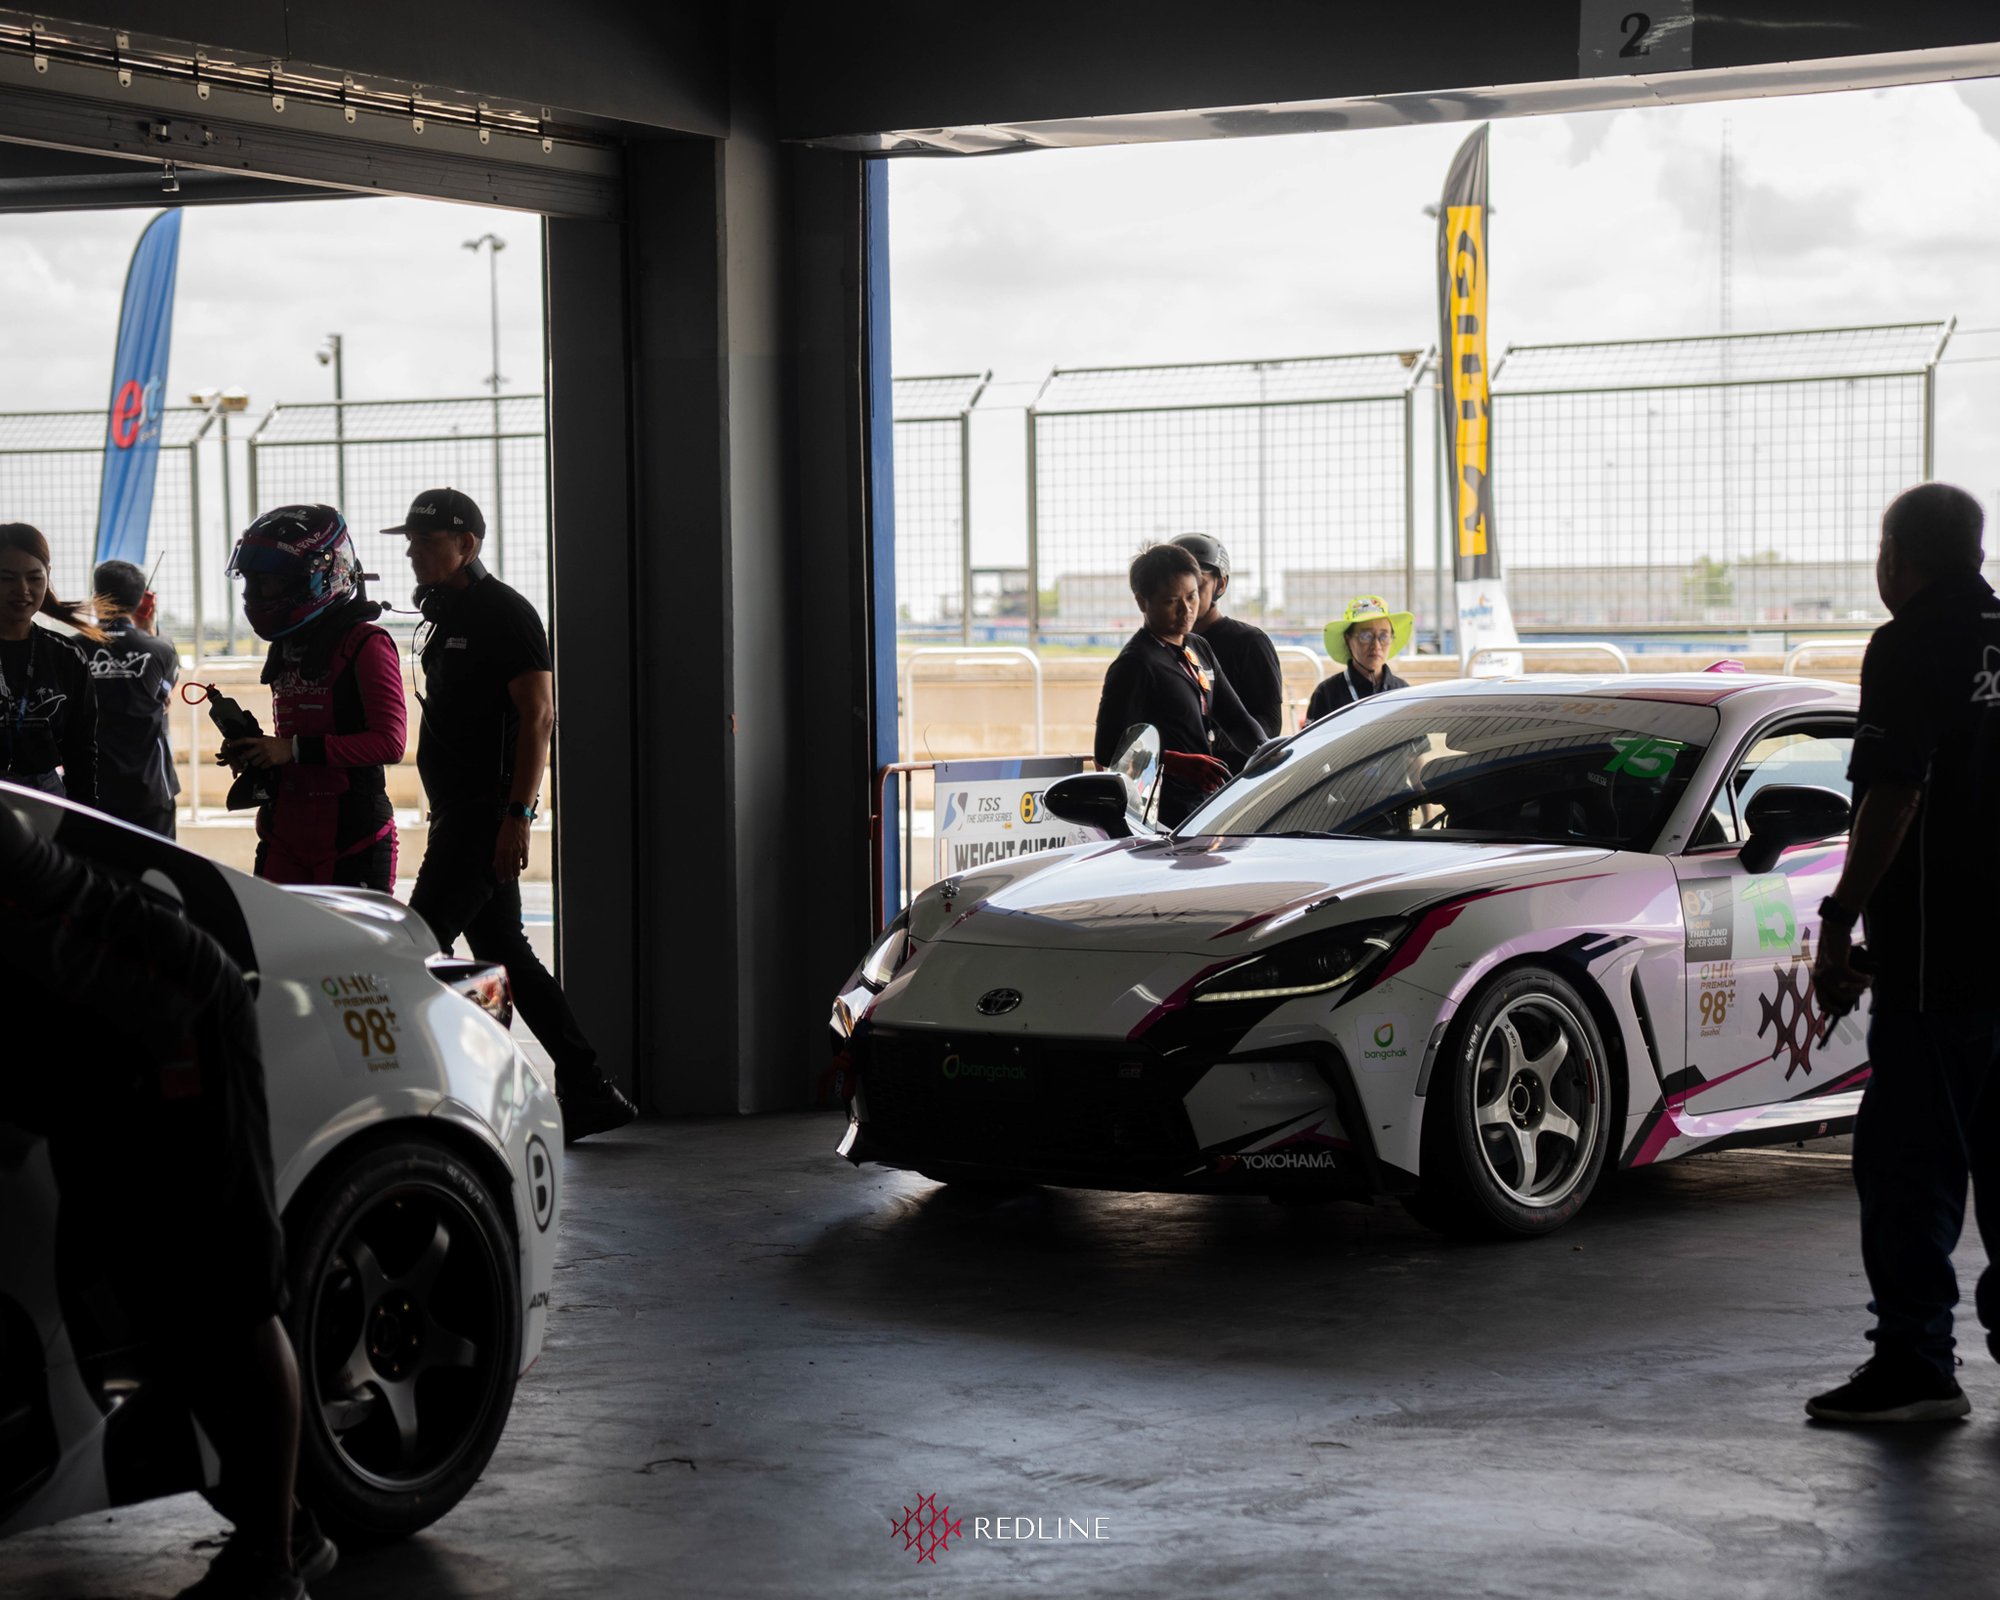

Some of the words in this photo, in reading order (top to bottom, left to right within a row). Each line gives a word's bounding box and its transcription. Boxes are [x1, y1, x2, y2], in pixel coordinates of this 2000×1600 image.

[1619, 12, 1651, 58] 2
[1436, 703, 1557, 713] PREMIUM
[1602, 736, 1690, 779] 15
[978, 796, 1002, 812] TSS
[966, 814, 977, 824] THE
[977, 813, 994, 824] SUPER
[994, 812, 1013, 822] SERIES
[954, 840, 1018, 872] WEIGHT
[1740, 876, 1796, 952] 15
[1689, 928, 1728, 939] THAILAND
[1688, 938, 1707, 949] SUPER
[1707, 937, 1728, 947] SERIES
[1700, 979, 1737, 990] PREMIUM
[333, 994, 389, 1009] PREMIUM
[1364, 1048, 1408, 1061] bangchak
[961, 1062, 1027, 1082] bangchak
[1242, 1153, 1336, 1169] YOKOHAMA
